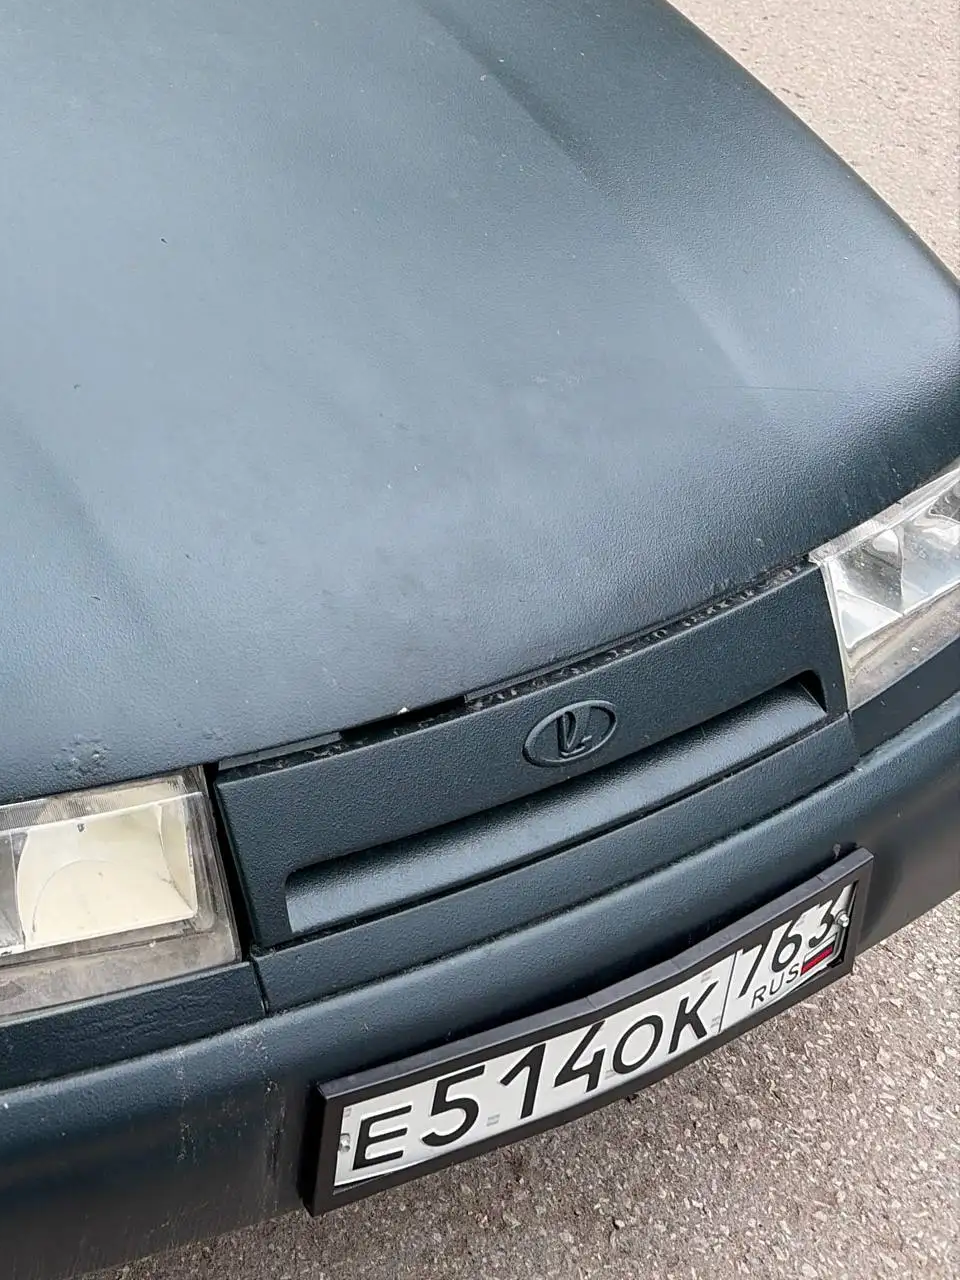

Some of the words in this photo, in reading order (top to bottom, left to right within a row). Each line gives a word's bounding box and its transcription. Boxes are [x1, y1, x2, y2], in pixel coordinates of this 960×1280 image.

[351, 981, 721, 1171] Е514ОК
[737, 898, 837, 999] 763
[750, 963, 800, 1009] RUS
